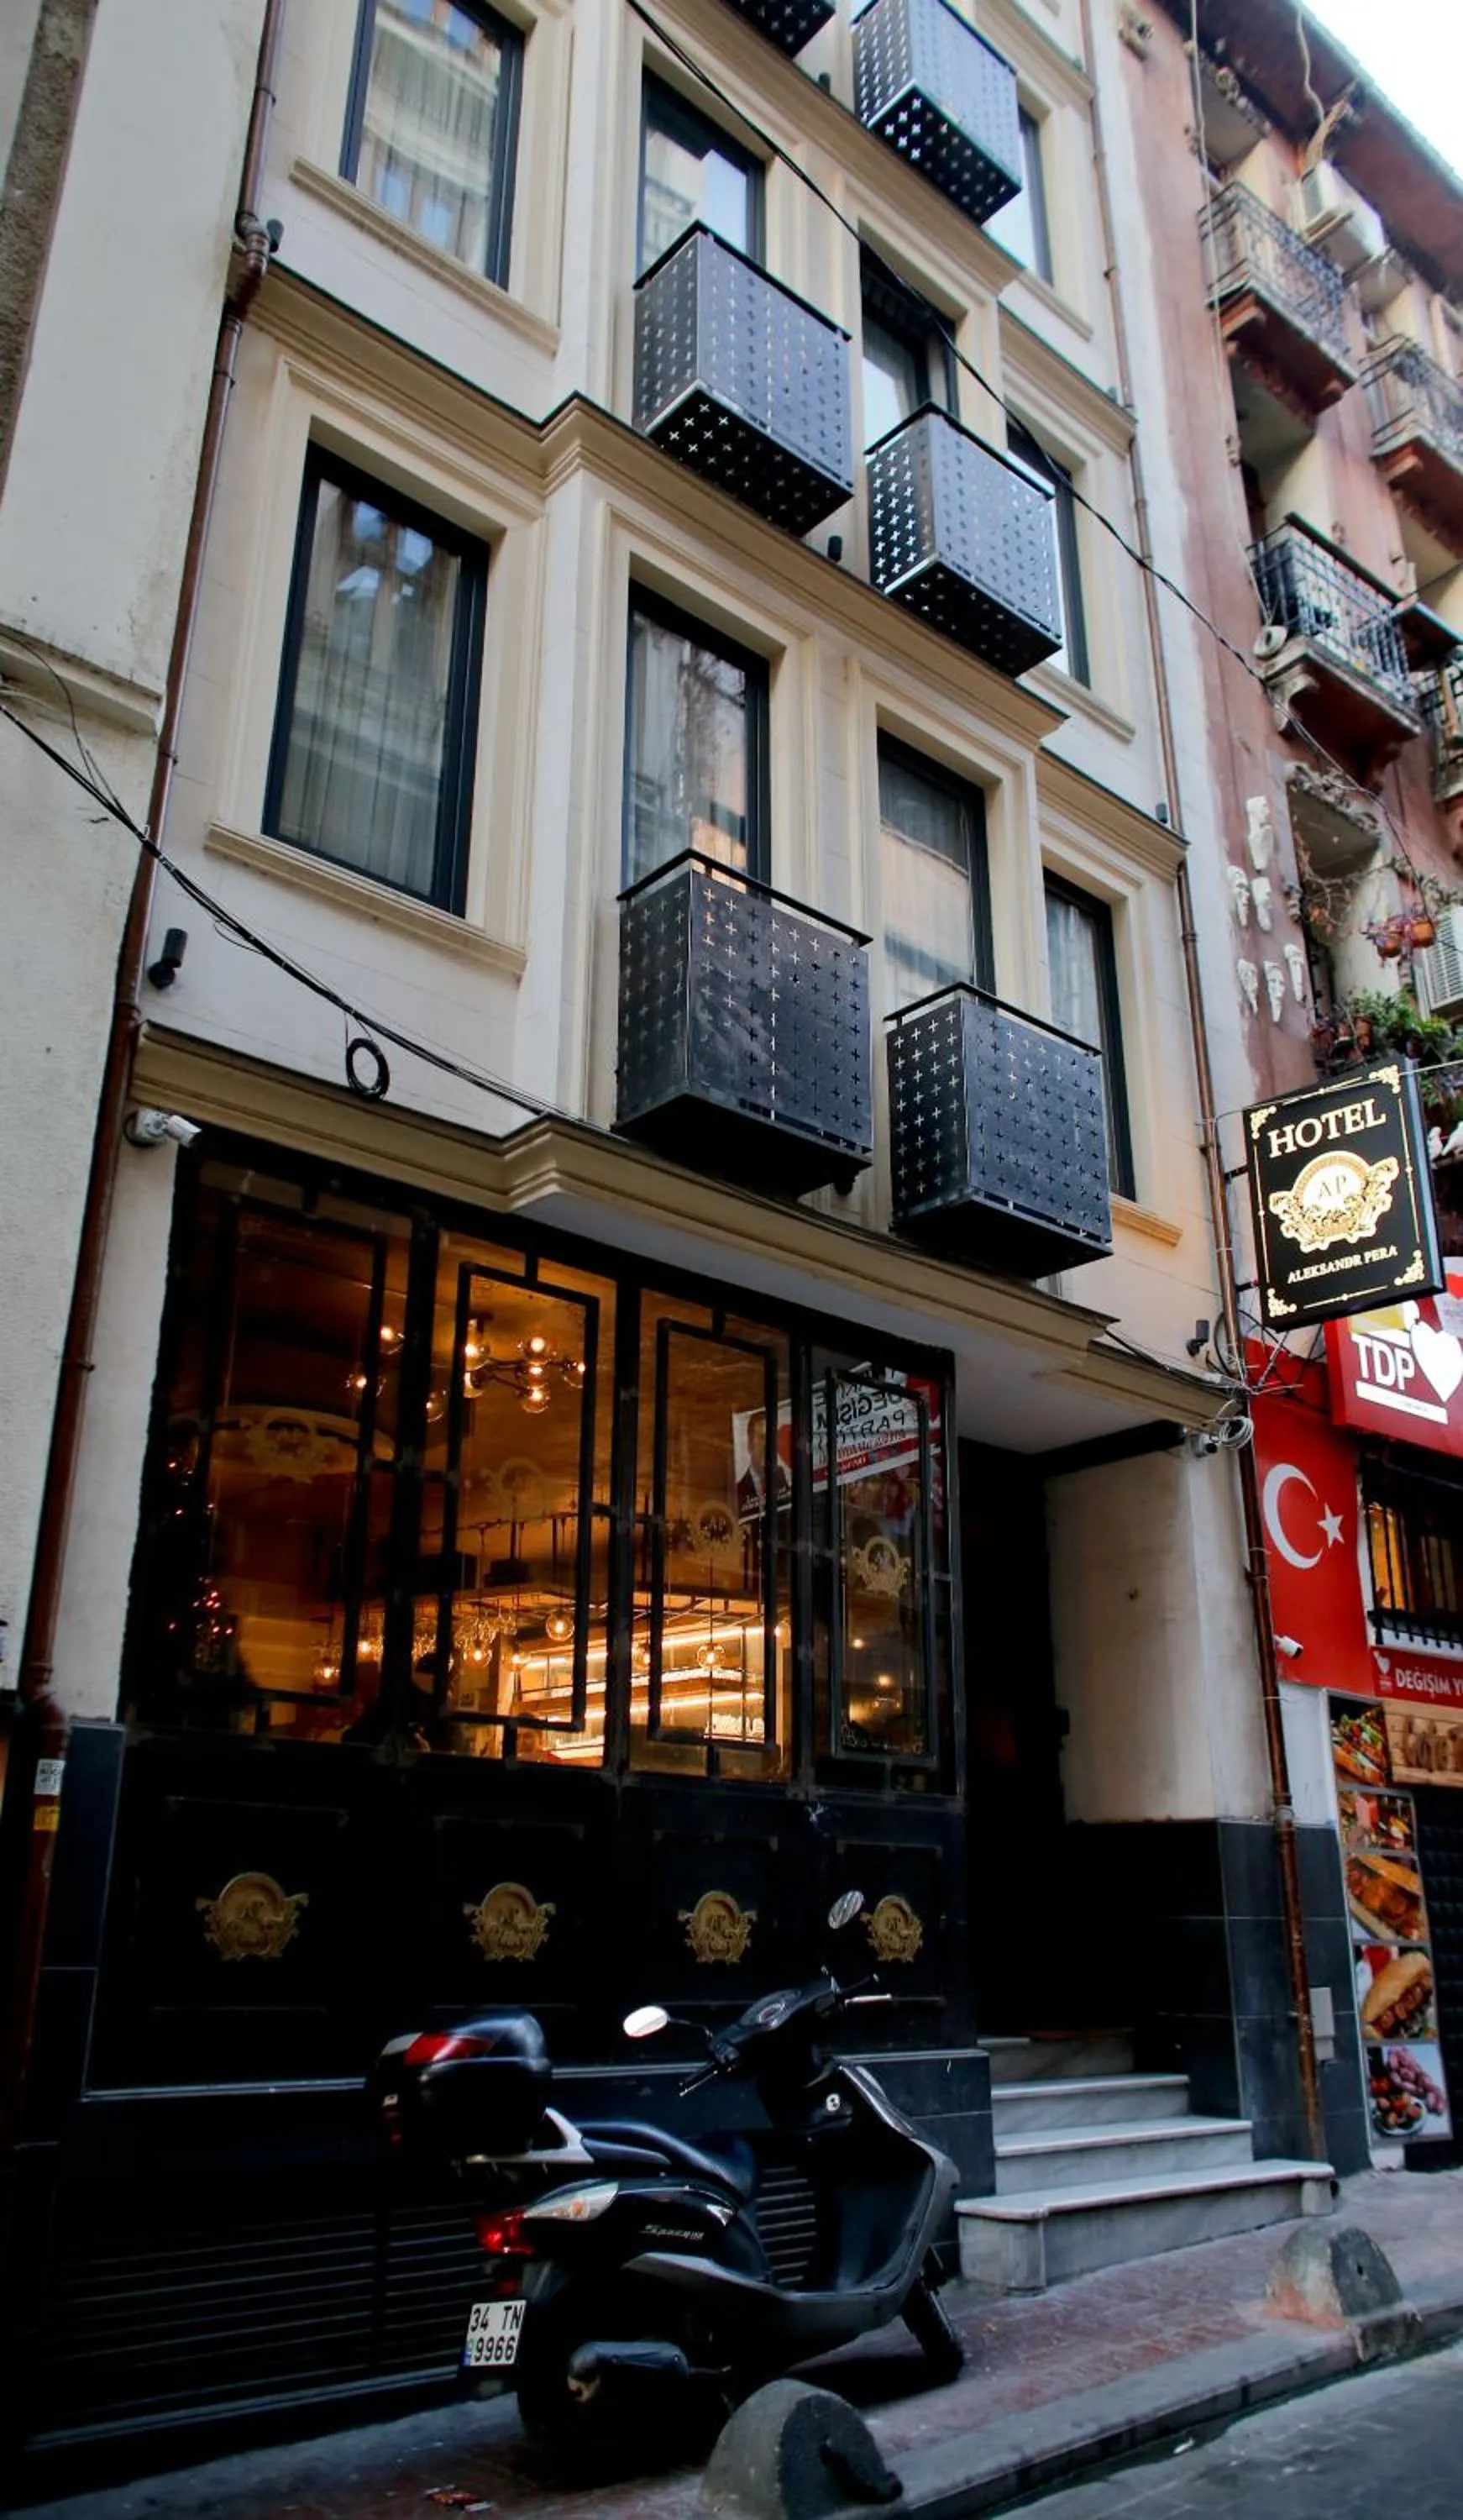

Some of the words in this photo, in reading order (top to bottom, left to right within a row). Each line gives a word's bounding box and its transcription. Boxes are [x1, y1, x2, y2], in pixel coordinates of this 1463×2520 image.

[1266, 1098, 1387, 1159] HOTEL
[1287, 1254, 1362, 1284] ALEKSANDR
[1363, 1244, 1398, 1264] PERA
[1350, 1331, 1416, 1391] TDP
[1394, 1667, 1452, 1700] DEĞİŞİM
[470, 2306, 490, 2333] 34
[501, 2305, 523, 2331] TN
[474, 2335, 516, 2363] 9966
